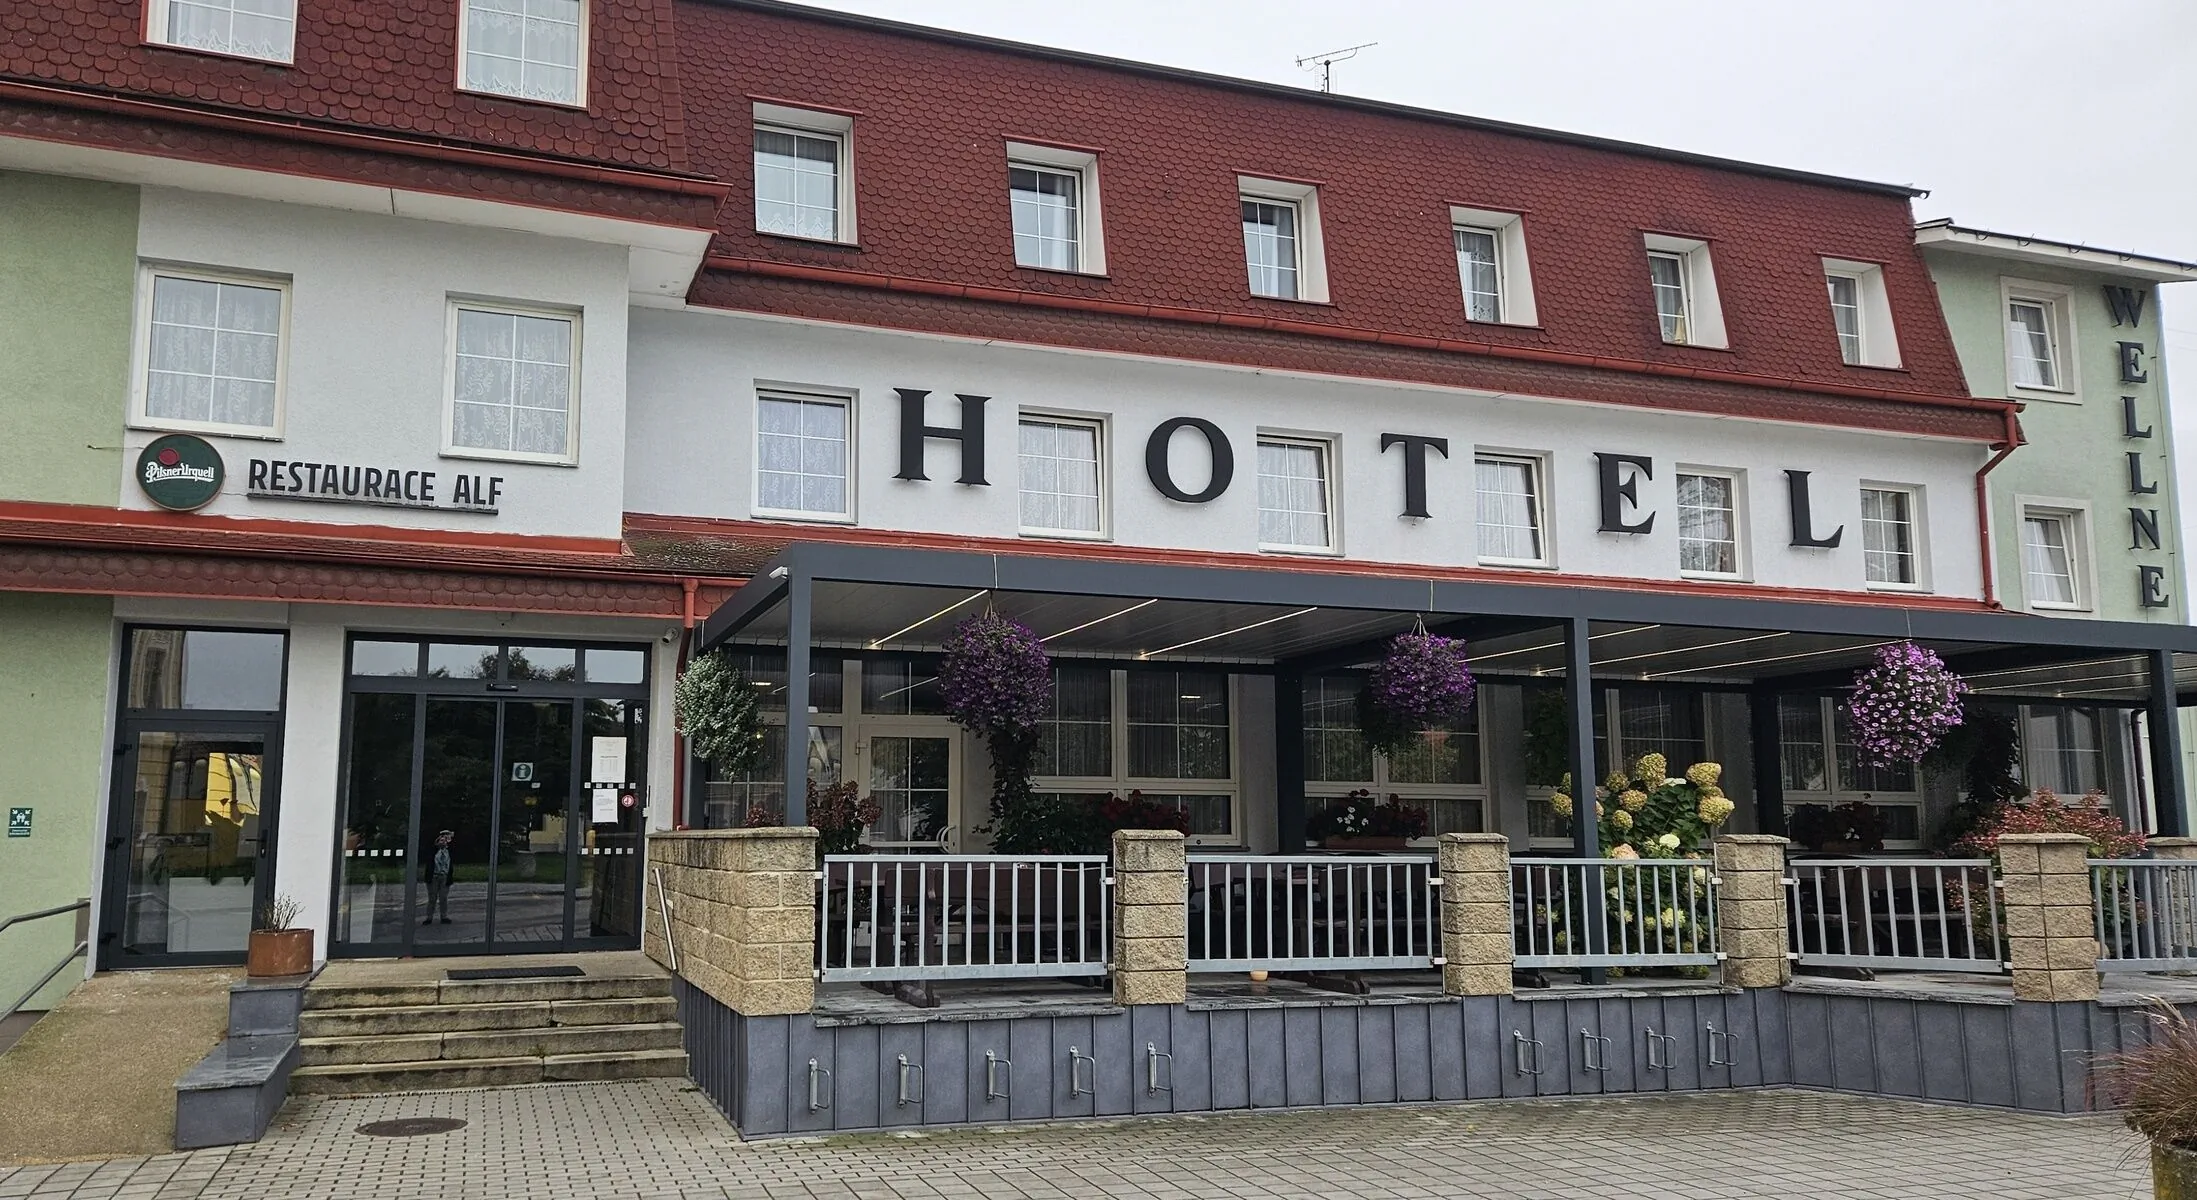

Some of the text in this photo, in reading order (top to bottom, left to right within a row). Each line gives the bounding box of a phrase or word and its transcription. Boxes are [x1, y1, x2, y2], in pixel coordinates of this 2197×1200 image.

[248, 459, 504, 506] RESTAURACE ALF
[892, 387, 1844, 550] HOTEL
